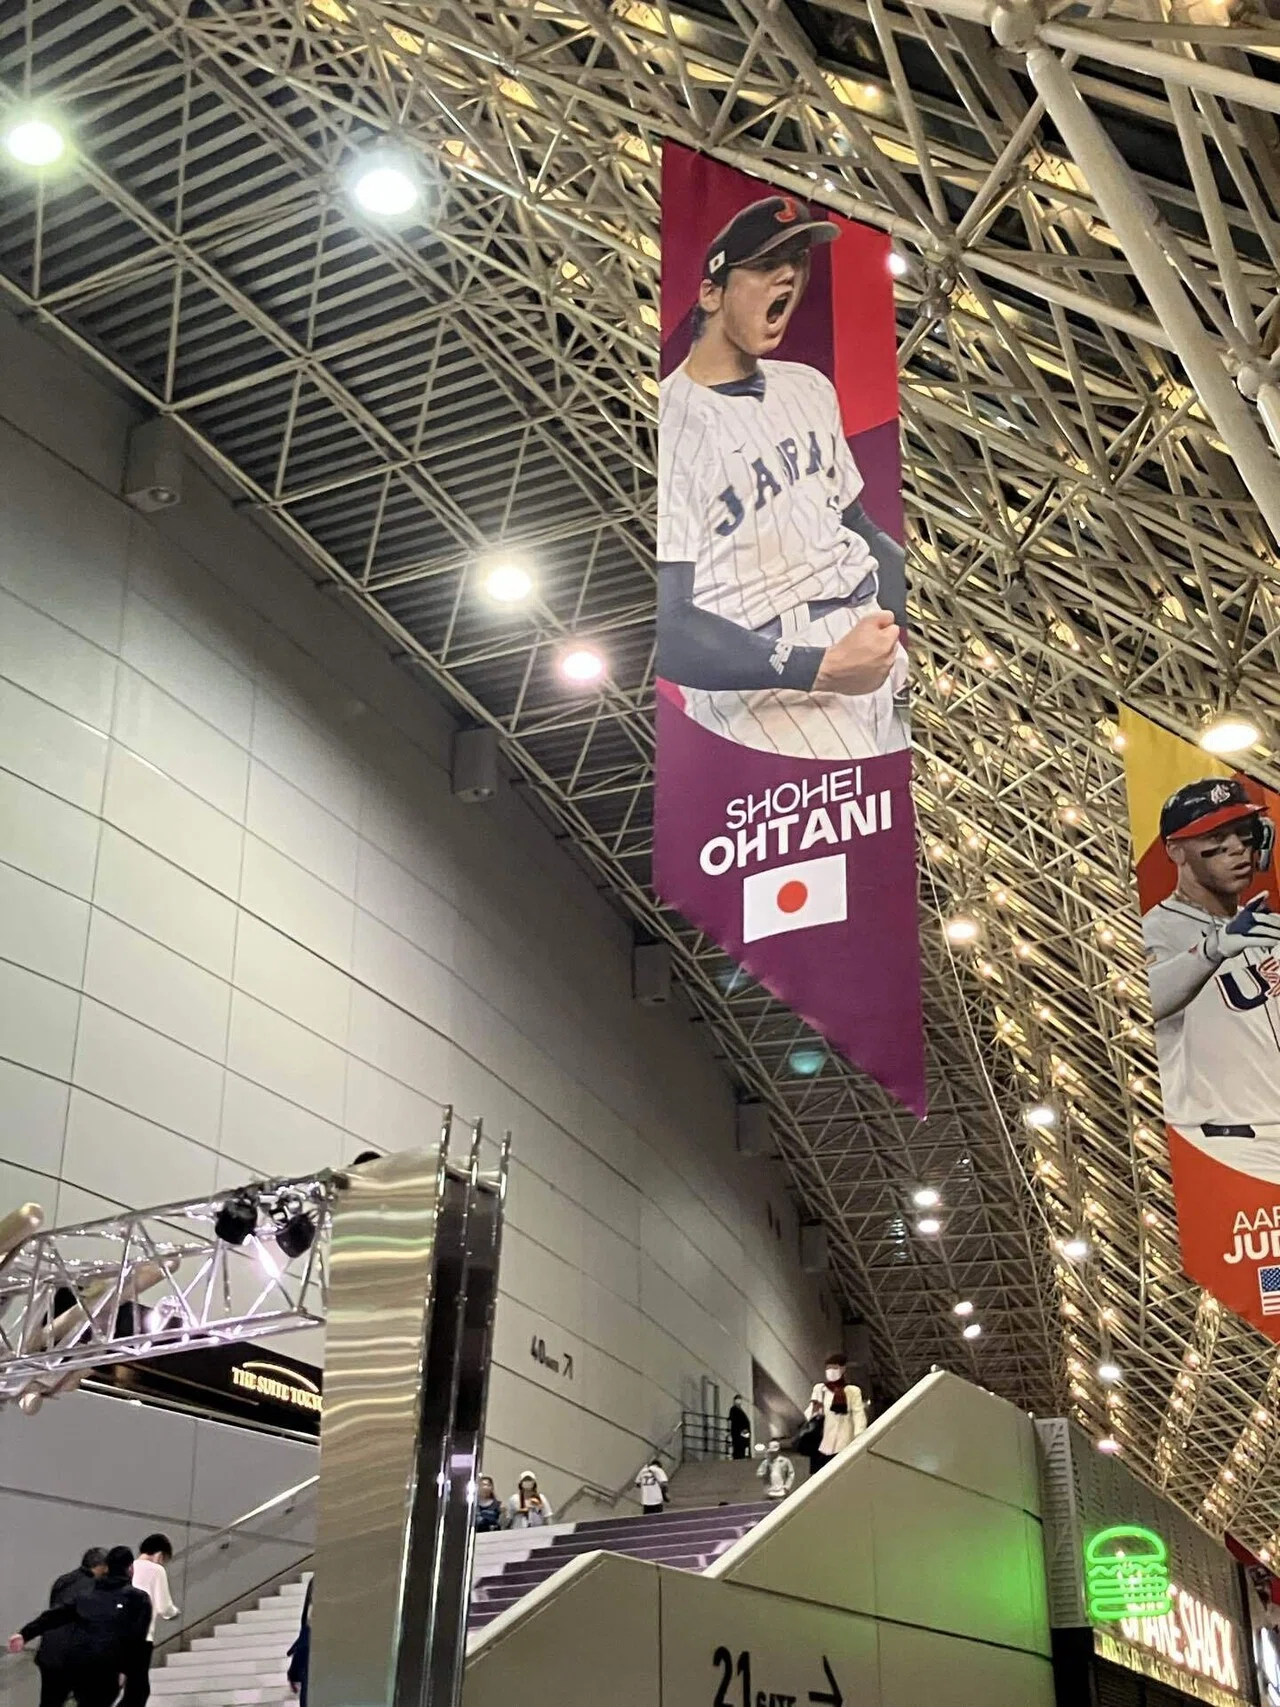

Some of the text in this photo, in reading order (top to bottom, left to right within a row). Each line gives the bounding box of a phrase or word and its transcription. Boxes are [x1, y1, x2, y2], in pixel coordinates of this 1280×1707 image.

[726, 765, 862, 829] SHOHEI
[700, 789, 892, 876] OHTANI
[231, 1366, 258, 1390] THE
[257, 1376, 290, 1401] SUITE
[1180, 1589, 1240, 1690] SHACK
[713, 1646, 750, 1707] 21
